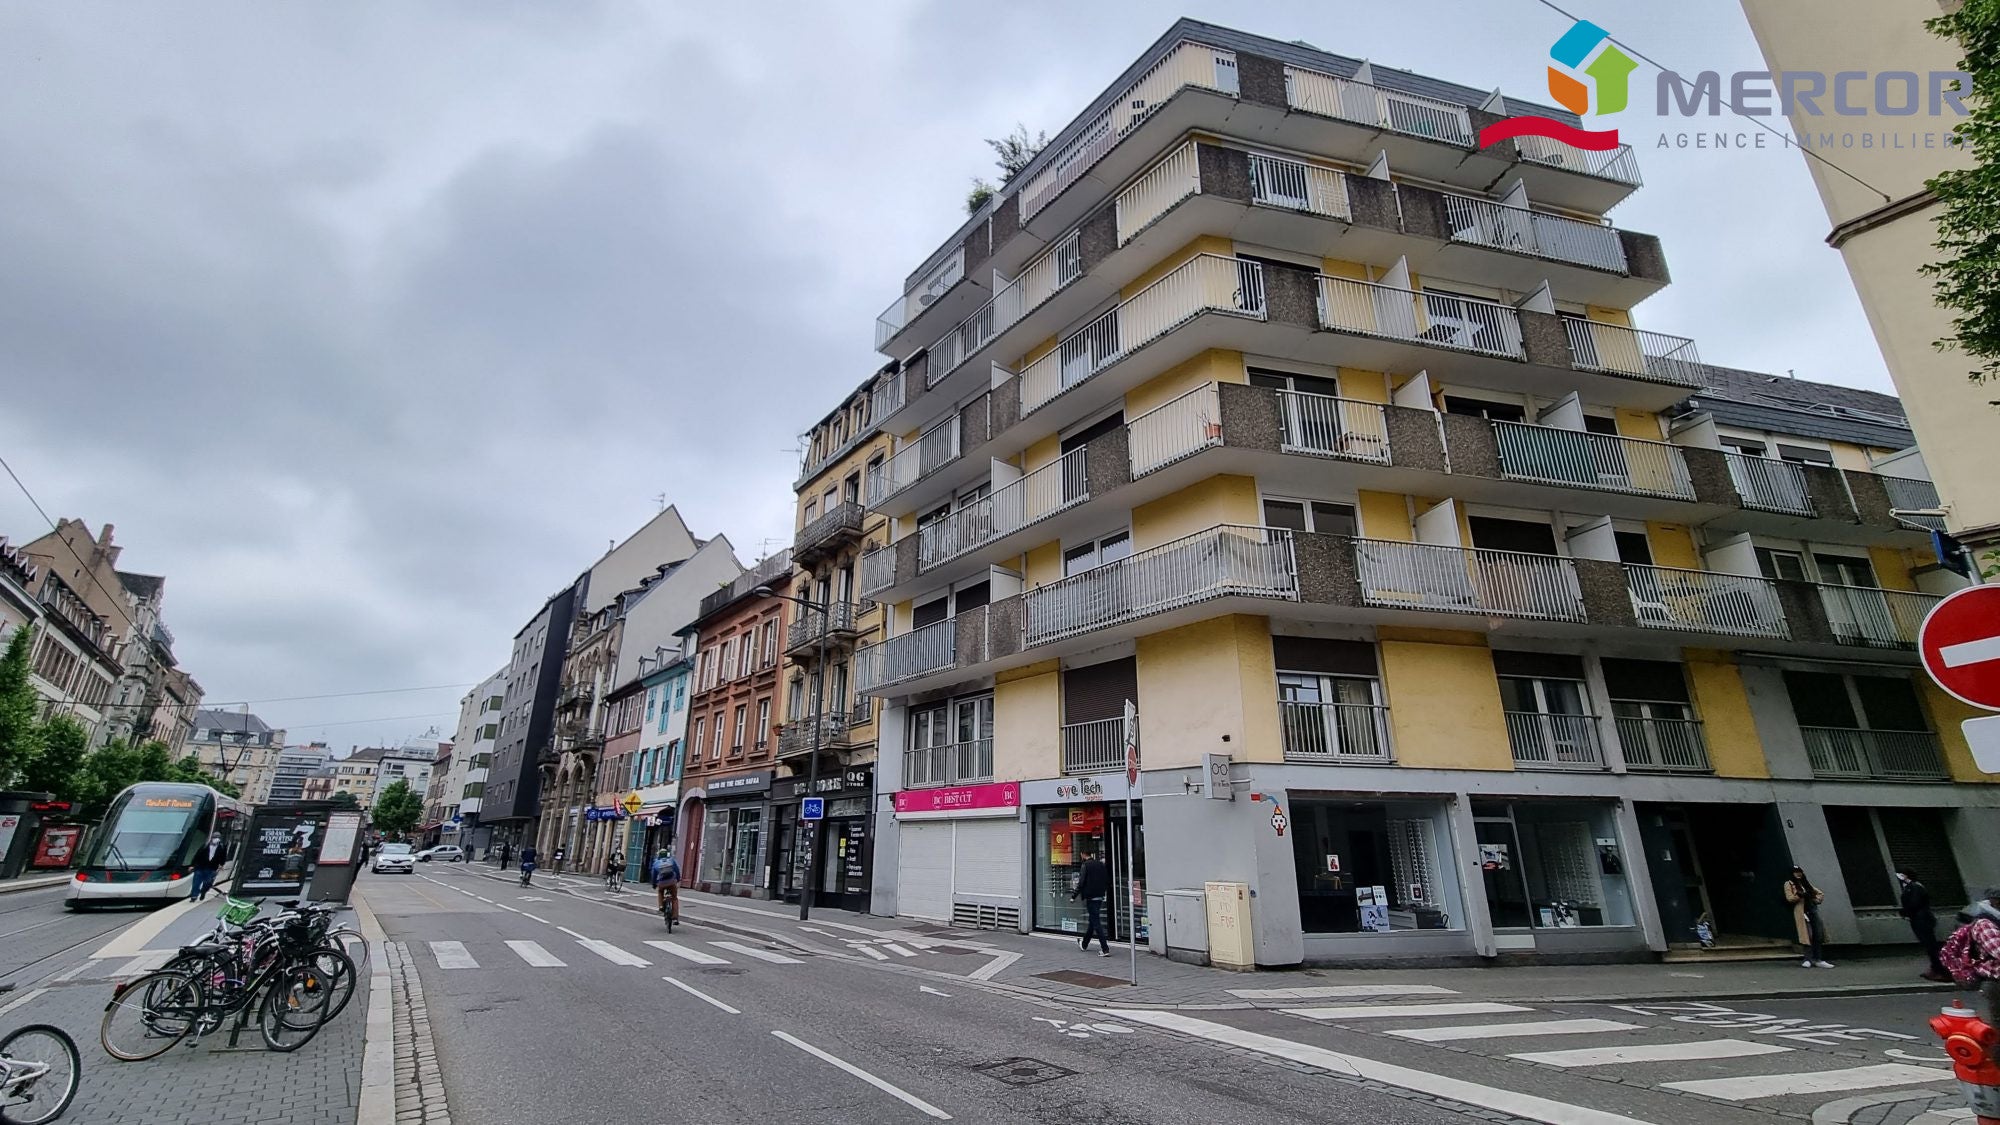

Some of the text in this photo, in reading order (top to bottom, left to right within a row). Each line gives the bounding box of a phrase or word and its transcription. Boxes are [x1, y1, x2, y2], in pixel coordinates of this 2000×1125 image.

[846, 771, 865, 782] QG
[944, 793, 972, 804] BEST CUT
